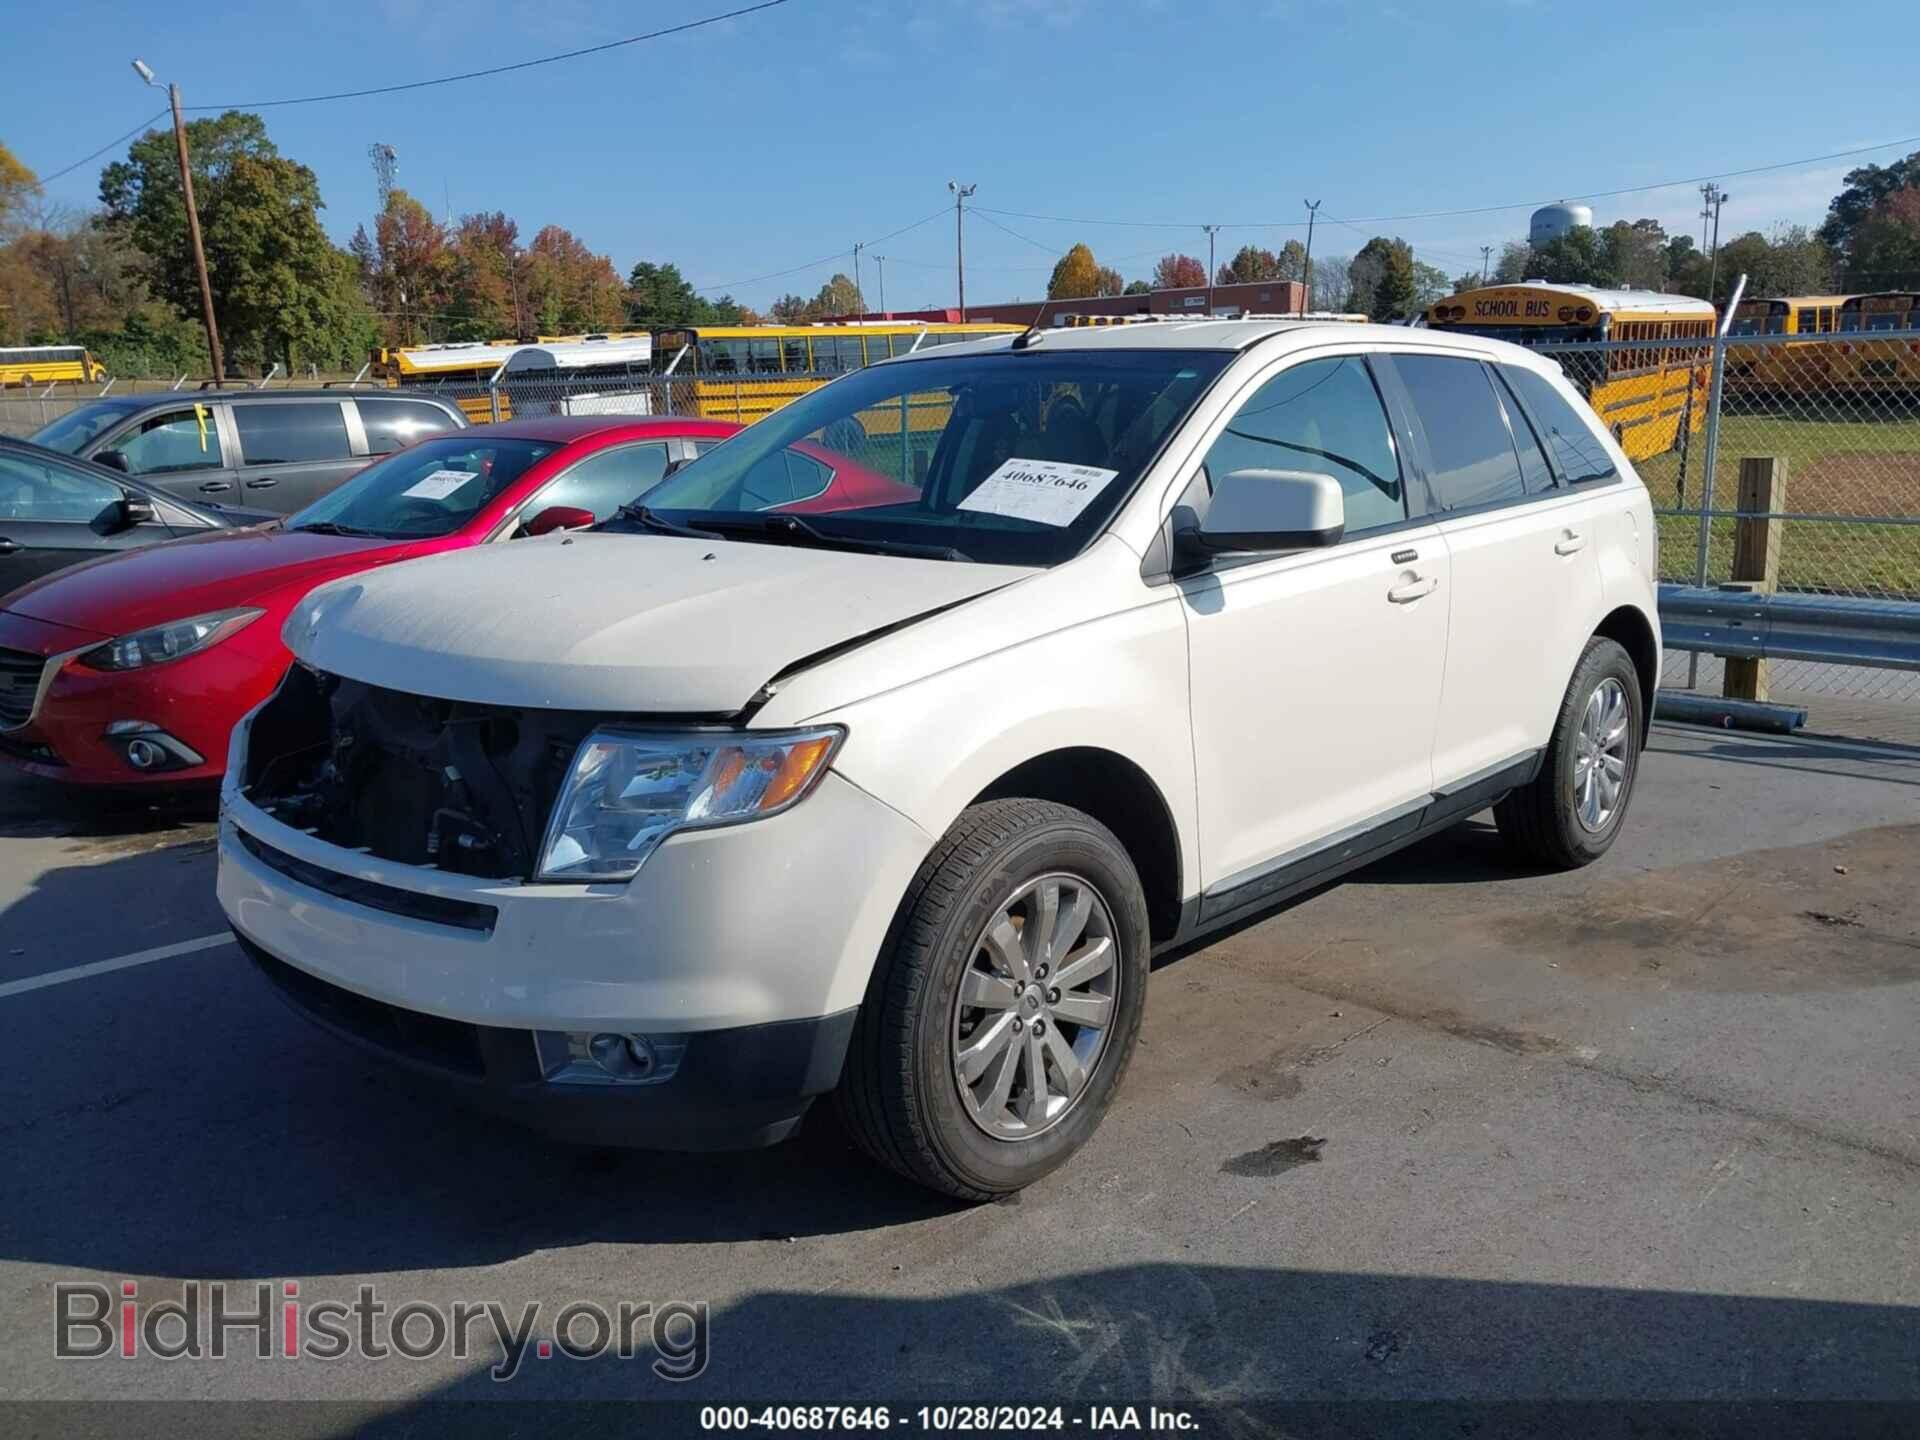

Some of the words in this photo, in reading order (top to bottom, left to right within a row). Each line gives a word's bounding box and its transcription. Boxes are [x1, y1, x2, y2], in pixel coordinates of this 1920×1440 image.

[1474, 300, 1520, 318] SCHOOL
[1525, 300, 1551, 318] BUS
[1002, 469, 1089, 491] 40687646
